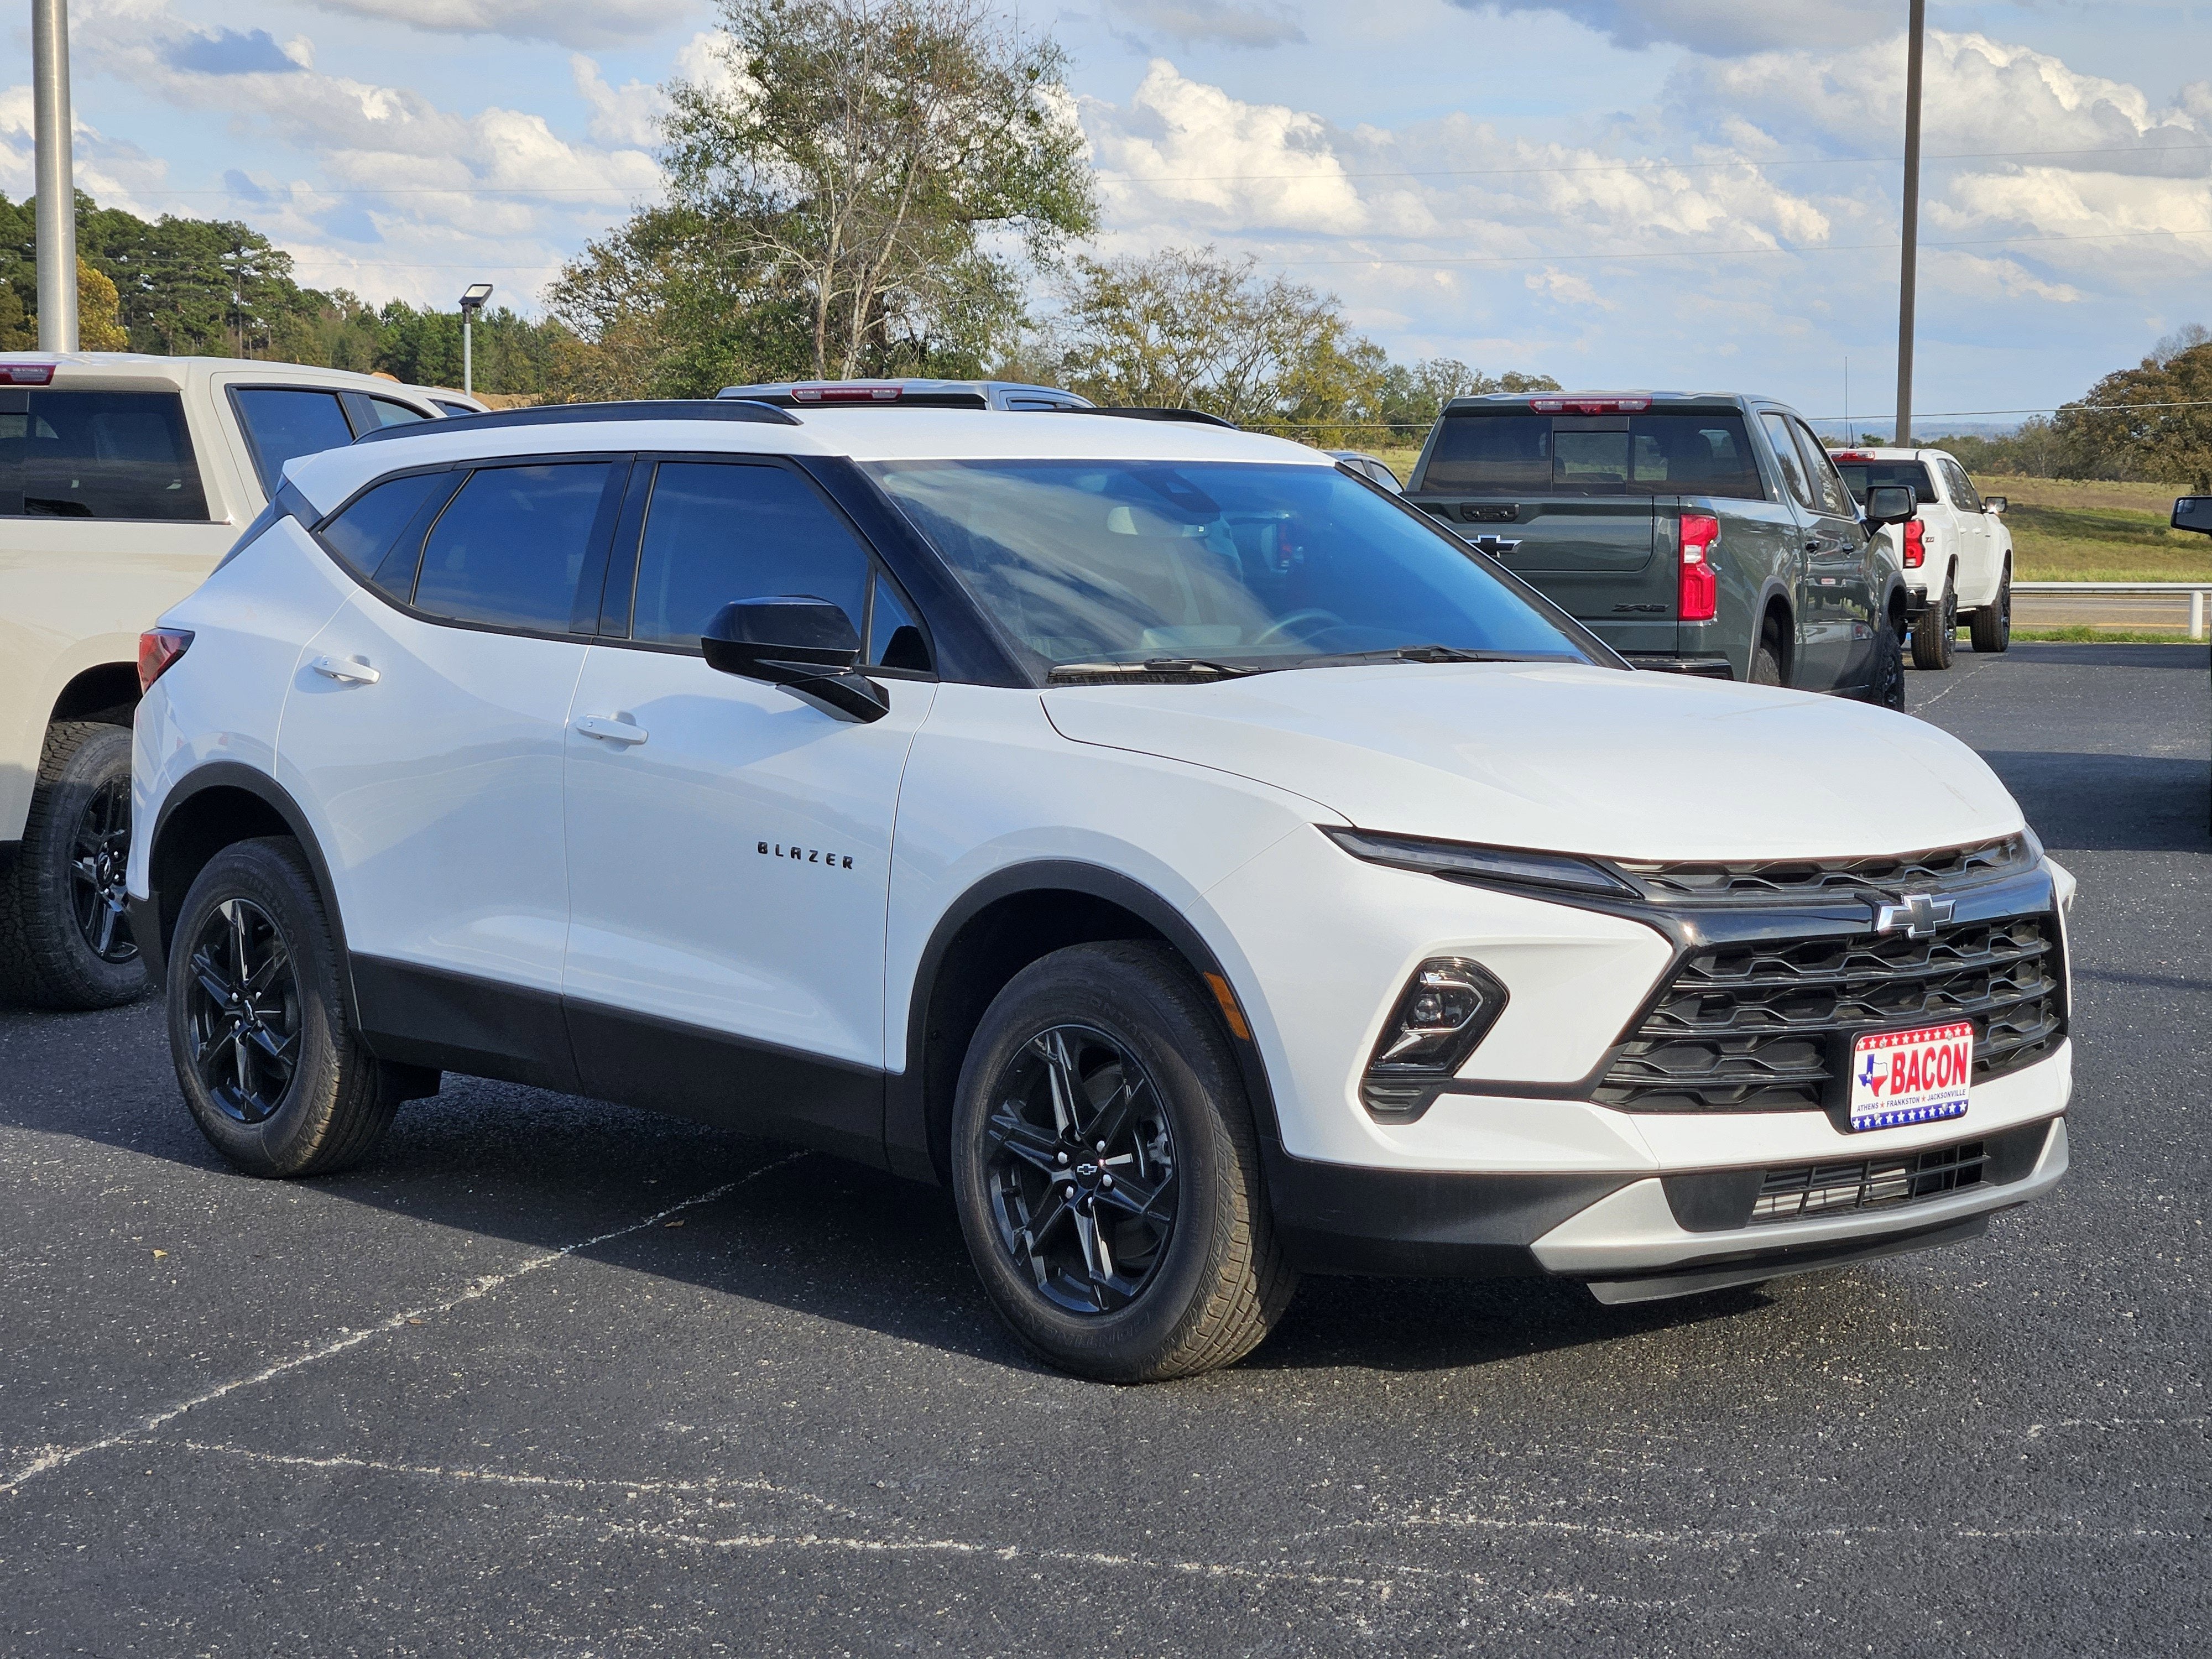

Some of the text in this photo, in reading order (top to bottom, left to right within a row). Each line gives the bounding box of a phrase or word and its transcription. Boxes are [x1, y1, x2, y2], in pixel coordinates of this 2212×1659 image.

[757, 841, 854, 869] BLAZER
[1890, 1042, 1969, 1095] BACON
[1856, 1088, 1966, 1113] ATHENS FRANKSTON JACKSONVILLE
